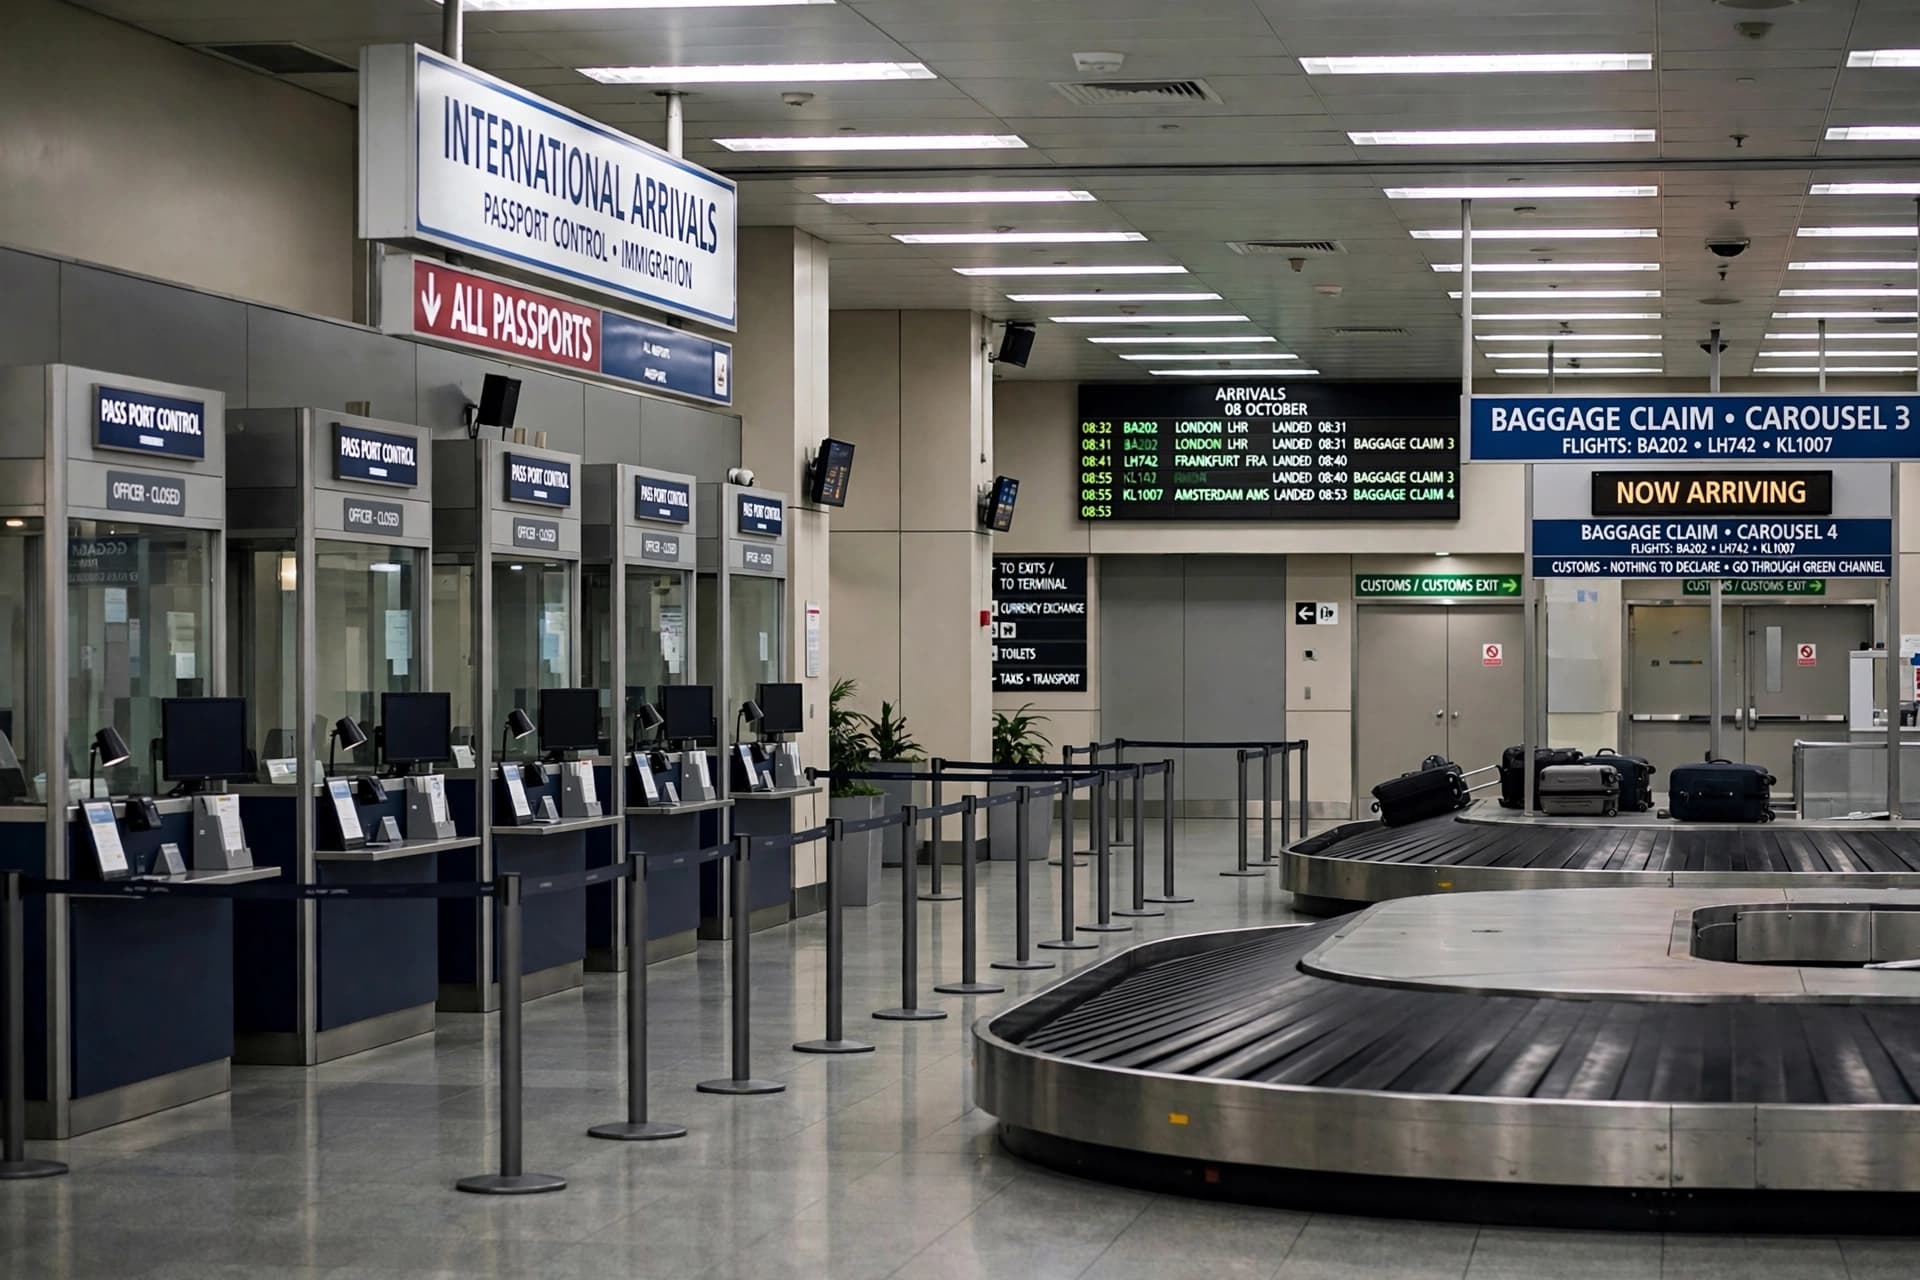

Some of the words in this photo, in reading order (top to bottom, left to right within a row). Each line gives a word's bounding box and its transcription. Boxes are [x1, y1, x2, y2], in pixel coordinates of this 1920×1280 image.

[444, 95, 625, 222] INTERNATIONAL
[631, 173, 717, 254] ARRIVALS
[484, 192, 548, 242] PASSPORT
[553, 215, 608, 262] CONTROL
[621, 239, 693, 289] IMMIGRATION
[450, 282, 488, 337] ALL
[493, 293, 592, 362] PASSPORTS
[1215, 387, 1286, 401] ARRIVALS
[1225, 402, 1242, 416] 08
[1245, 402, 1308, 416] OCTOBER
[101, 398, 127, 425] PASS
[128, 403, 156, 429] PORT
[157, 408, 202, 435] CONTROL
[1491, 407, 1621, 432] BAGGAGE
[1630, 406, 1714, 431] CLAIM
[1745, 405, 1887, 431] CAROUSEL
[1895, 405, 1910, 430] 3
[1082, 421, 1112, 434] 08:32
[1123, 421, 1158, 434] BA202
[1175, 421, 1222, 434] LONDON
[1227, 421, 1248, 434] LHR
[1272, 421, 1312, 434] LANDED
[1318, 421, 1346, 434] 08:31
[1082, 438, 1111, 450] 08:31
[1175, 438, 1222, 450] LONDON
[1227, 438, 1248, 450] LHR
[1272, 438, 1312, 450] LANDED
[1318, 438, 1346, 450] 08:31
[1353, 438, 1406, 450] BAGGAGE
[1409, 438, 1444, 450] CLAIM
[1448, 438, 1455, 450] 3
[1563, 437, 1632, 454] FLIGHTS:
[1637, 437, 1688, 453] BA202
[1708, 437, 1756, 453] LH742
[1776, 437, 1833, 453] KL1007
[341, 436, 361, 458] PASS
[361, 439, 382, 461] PORT
[382, 443, 416, 466] CONTROL
[1082, 455, 1111, 467] 08:41
[1124, 455, 1159, 467] LH742
[1174, 455, 1240, 467] FRANKFURT
[1245, 455, 1268, 467] FRA
[1272, 455, 1312, 467] LANDED
[1318, 455, 1348, 467] 08:40
[1082, 472, 1112, 484] 08:55
[1272, 472, 1312, 484] LANDED
[1318, 472, 1348, 484] 08:40
[1353, 472, 1406, 484] BAGGAGE
[1409, 472, 1444, 484] CLAIM
[1447, 472, 1454, 484] 3
[151, 486, 180, 505] CLOSED
[1082, 489, 1112, 501] 08:55
[1123, 489, 1164, 501] KL1007
[1174, 489, 1243, 501] AMSTERDAM
[1246, 489, 1269, 501] AMS
[1274, 489, 1314, 501] LANDED
[1319, 489, 1348, 501] 08:53
[1353, 489, 1406, 501] BAGGAGE
[1409, 489, 1444, 501] CLAIM
[1447, 489, 1455, 501] 4
[1617, 481, 1680, 504] NOW
[1686, 480, 1806, 504] ARRIVING
[1082, 505, 1111, 517] 08:53
[1581, 524, 1661, 540] BAGGAGE
[1666, 524, 1718, 540] CLAIM
[1737, 524, 1823, 540] CAROUSEL
[1827, 524, 1838, 539] 4
[1631, 543, 1673, 554] FLIGHTS:
[1676, 543, 1707, 554] BA202
[1719, 543, 1749, 554] LH742
[1760, 543, 1795, 554] KL1007
[1000, 562, 1015, 574] TO
[1019, 562, 1046, 575] EXITS
[1552, 560, 1600, 573] CUSTOMS
[1610, 560, 1656, 573] NOTHING
[1659, 560, 1673, 573] TO
[1676, 560, 1720, 573] DECLARE
[1732, 560, 1748, 573] GO
[1751, 560, 1800, 573] THROUGH
[1803, 560, 1836, 573] GREEN
[1839, 560, 1885, 573] CHANNEL
[1000, 578, 1015, 590] TO
[1017, 578, 1068, 590] TERMINAL
[1360, 579, 1411, 592] CUSTOMS
[1422, 579, 1473, 592] CUSTOMS
[1476, 579, 1499, 592] EXIT
[1687, 580, 1732, 591] CUSTMS
[1741, 580, 1784, 591] CUSTOMS
[1787, 580, 1807, 591] EXIT
[1001, 602, 1042, 615] CURRENCY
[1043, 602, 1085, 615] EXCHANGE
[1000, 648, 1036, 660] TOILETS
[1032, 673, 1080, 685] TRANSPORT
